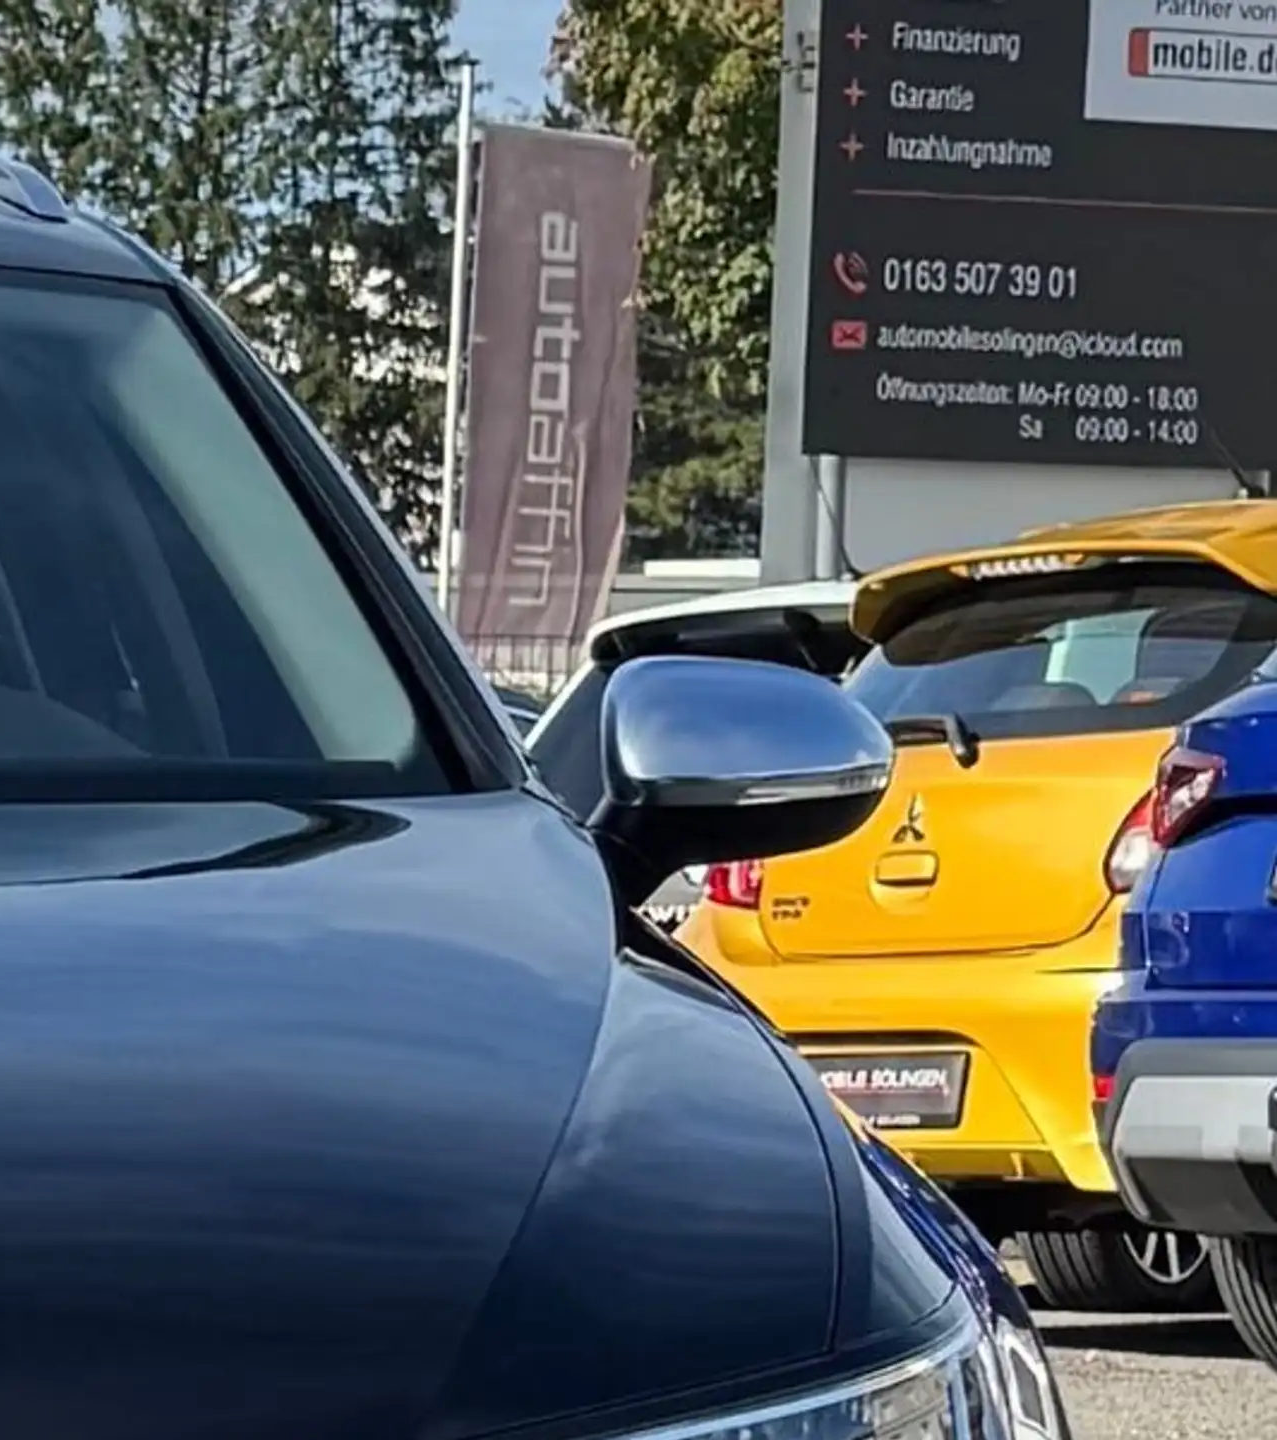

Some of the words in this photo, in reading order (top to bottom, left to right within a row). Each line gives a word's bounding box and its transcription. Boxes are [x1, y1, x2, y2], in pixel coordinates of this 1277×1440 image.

[892, 21, 1021, 62] Finanzierung
[1152, 38, 1277, 75] mobile.d
[890, 79, 975, 112] Garantie
[886, 131, 1053, 170] Inzahlungnahme
[884, 257, 947, 293] 0163
[954, 261, 1004, 295] 507
[1008, 264, 1042, 297] 39
[1048, 266, 1079, 299] 01
[876, 324, 1184, 358] automobilesolingen@icloud.com
[507, 210, 583, 608] autoaffin
[1018, 413, 1044, 439] Sa
